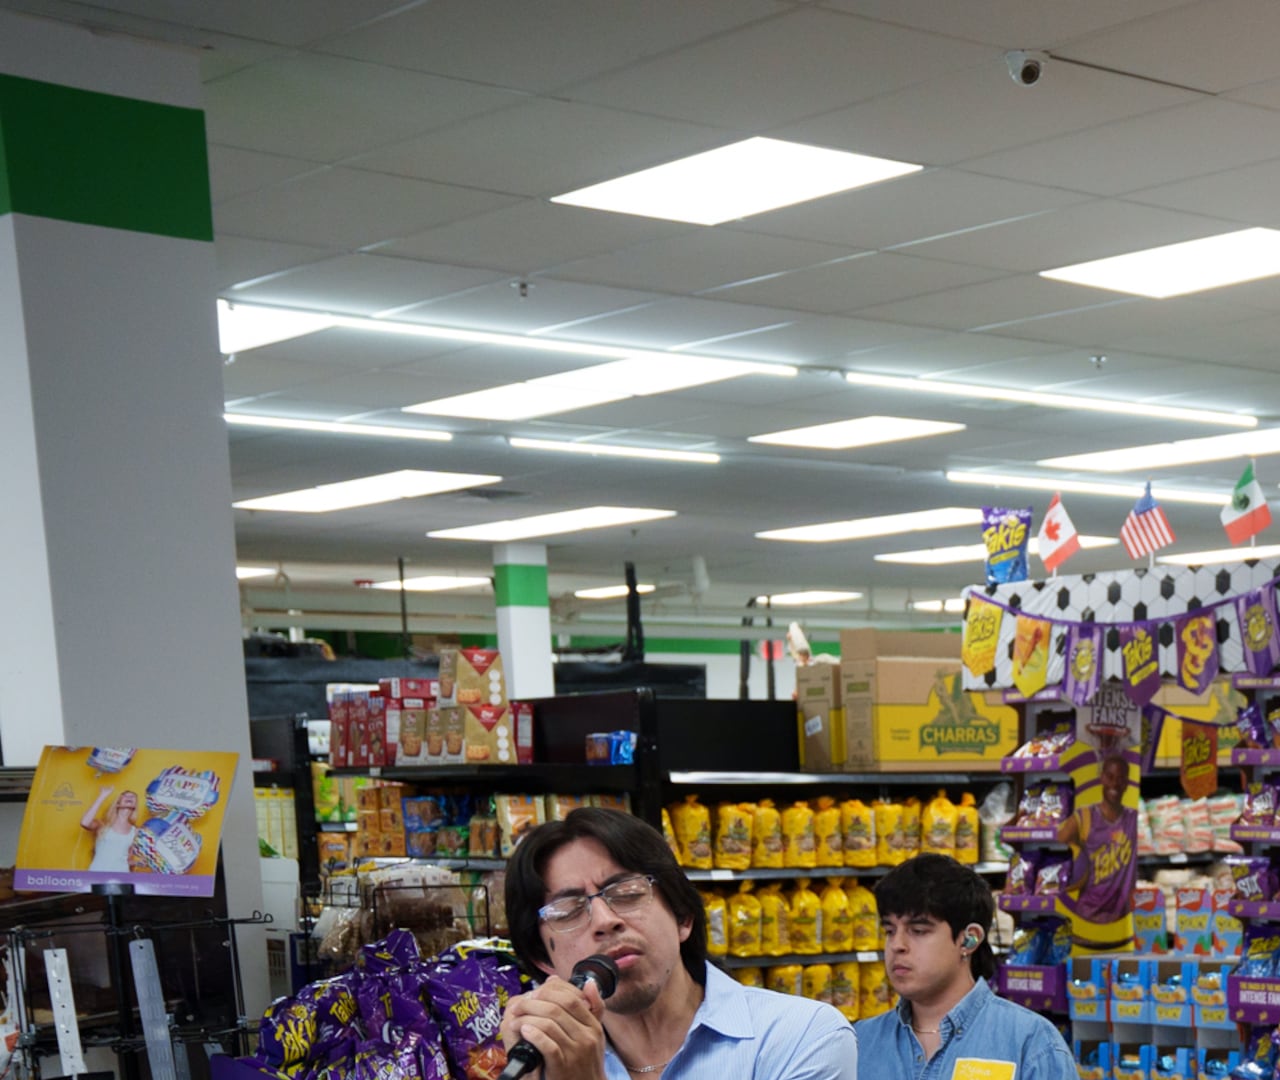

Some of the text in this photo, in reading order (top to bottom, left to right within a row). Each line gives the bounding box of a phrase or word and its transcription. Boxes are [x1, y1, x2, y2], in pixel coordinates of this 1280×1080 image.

[982, 522, 1027, 552] Takis
[1122, 637, 1153, 672] Takis
[1093, 707, 1127, 727] FANS
[922, 726, 997, 745] CHARRAS
[27, 875, 83, 888] balloons
